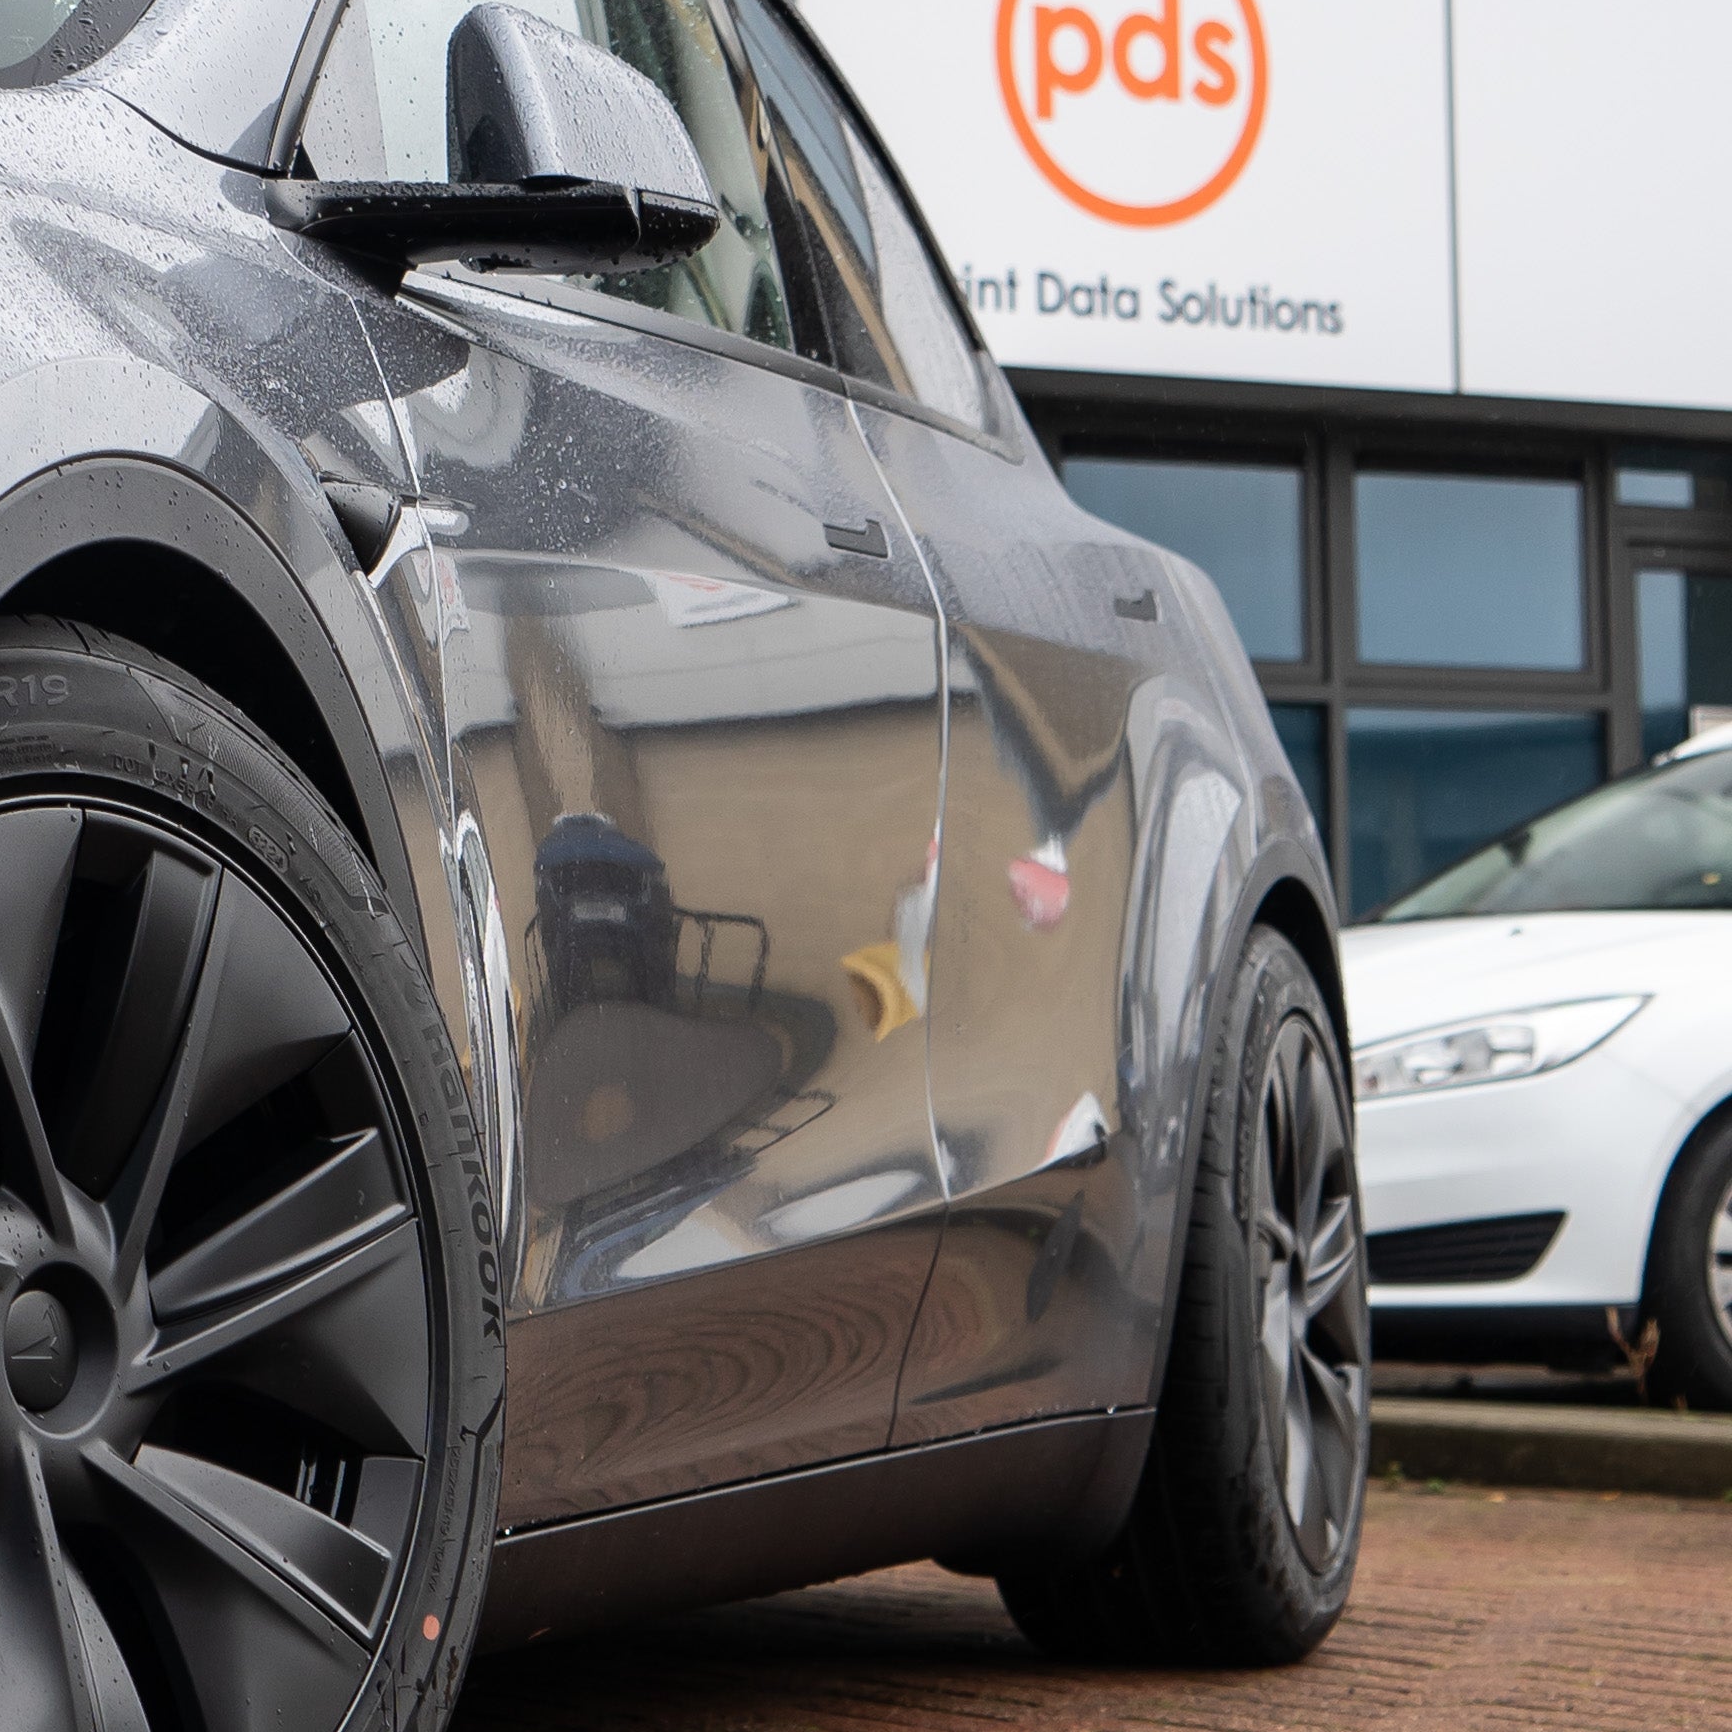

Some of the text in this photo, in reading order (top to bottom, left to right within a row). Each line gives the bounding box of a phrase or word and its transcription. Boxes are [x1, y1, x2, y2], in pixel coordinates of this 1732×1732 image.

[960, 265, 1344, 336] int Data Solutions
[421, 1023, 503, 1345] Hankook
